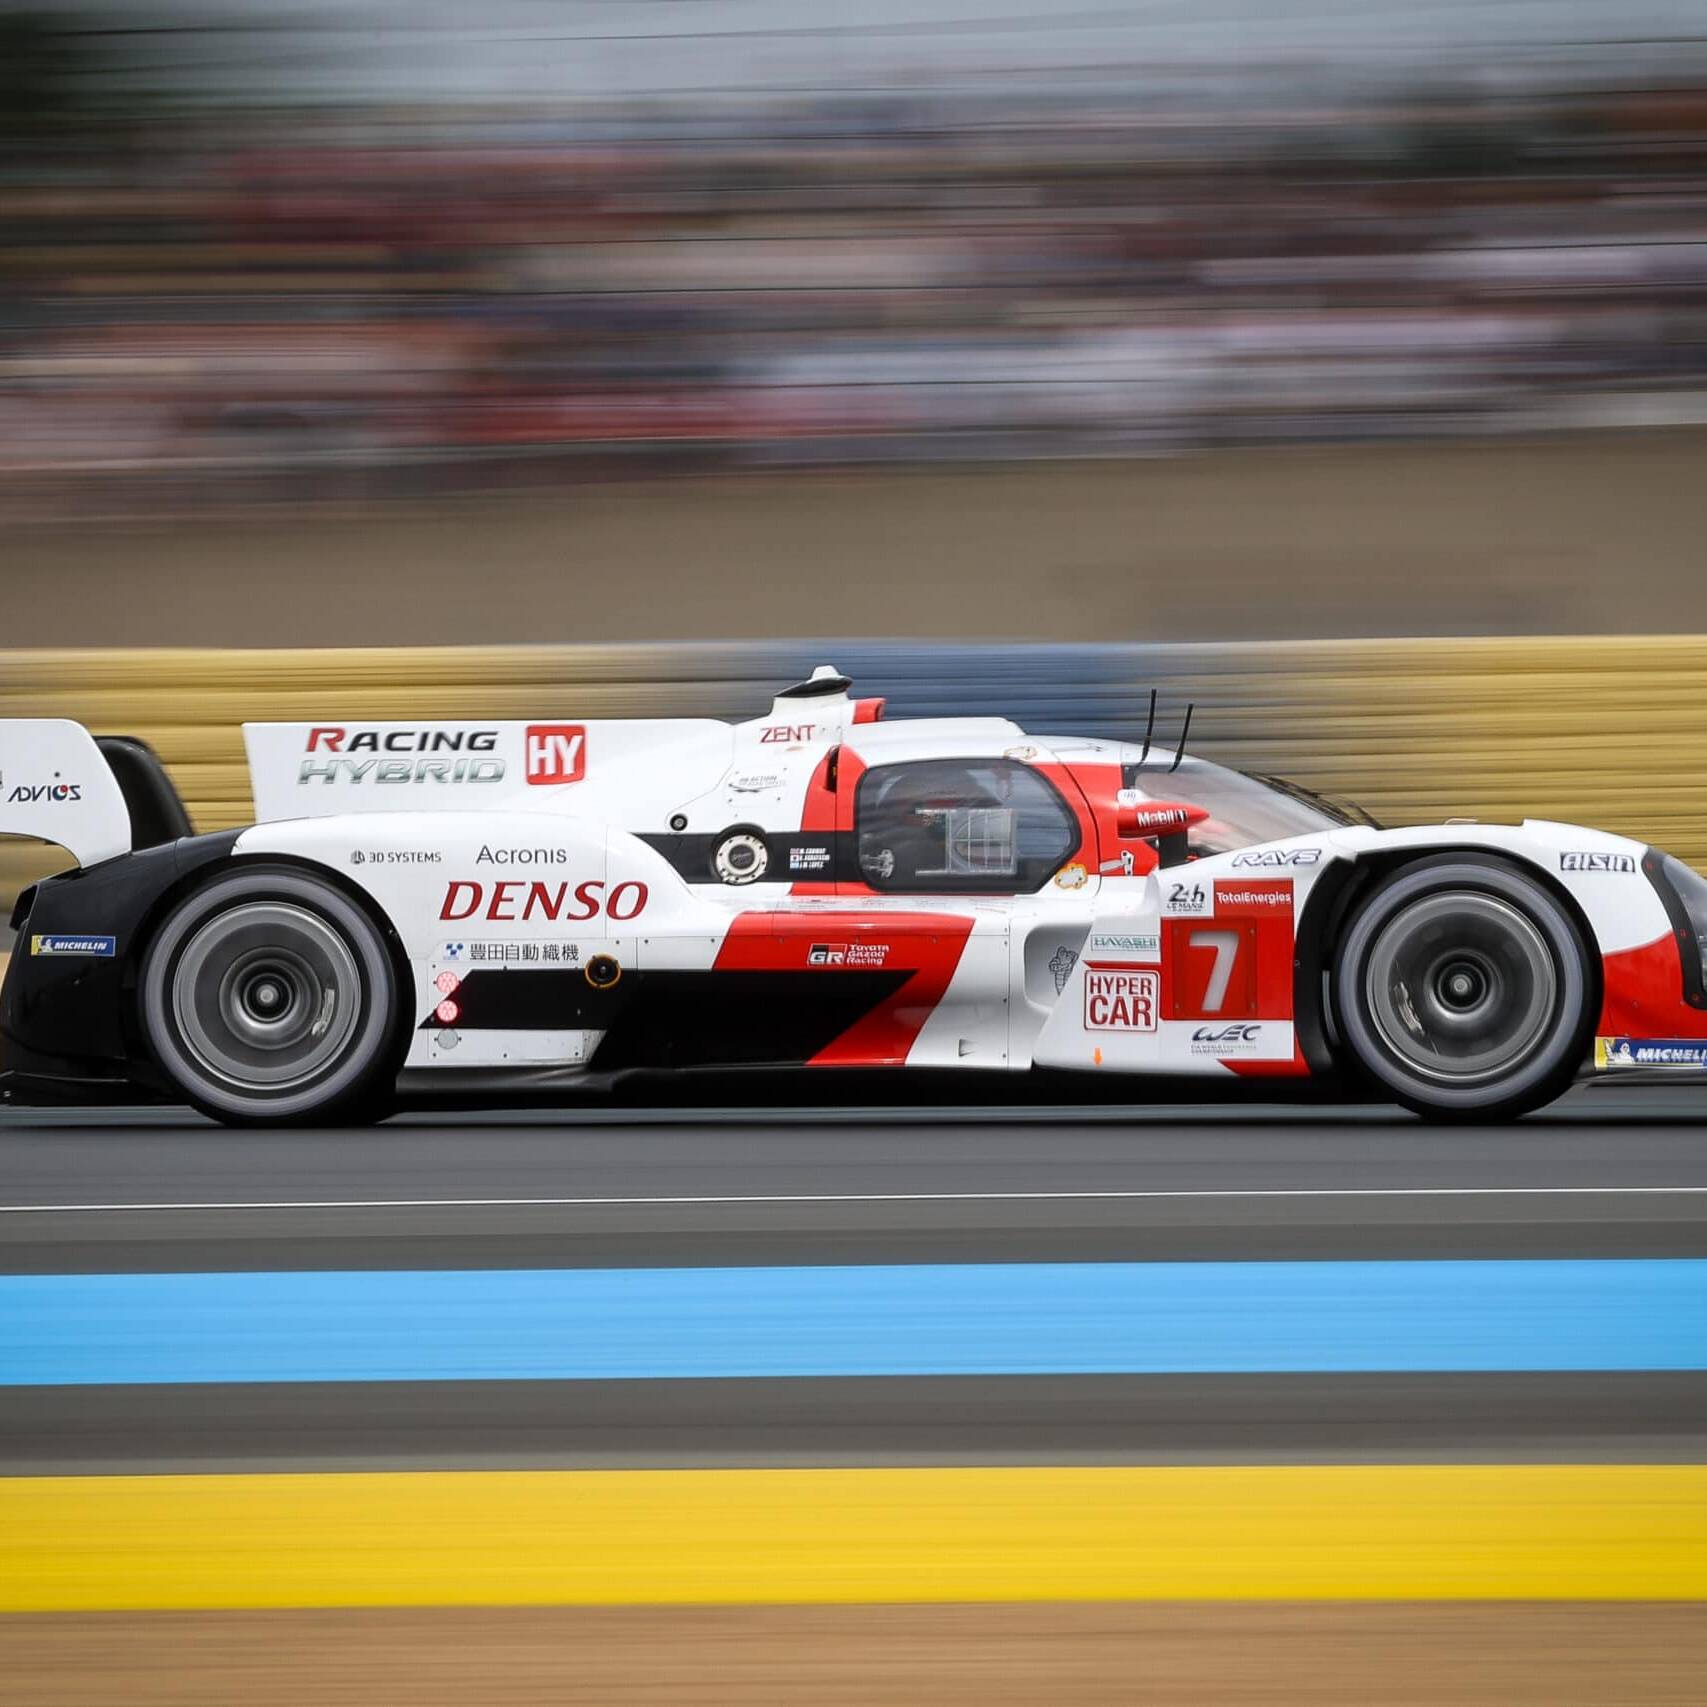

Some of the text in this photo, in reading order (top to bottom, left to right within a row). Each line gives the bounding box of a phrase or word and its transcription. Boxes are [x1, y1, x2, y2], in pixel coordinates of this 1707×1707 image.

[305, 728, 498, 752] RACING
[760, 725, 815, 743] ZENT
[528, 735, 583, 775] HY
[297, 758, 505, 784] HYBRID
[8, 784, 81, 802] ADVICS
[369, 852, 441, 863] 3D SYSTEMS
[476, 845, 567, 864] Acronis
[1232, 848, 1322, 867] RAYS
[1561, 852, 1635, 872] AISIN
[439, 881, 648, 920] DENSO
[1216, 891, 1291, 905] TotalEnergies
[54, 941, 107, 951] MICHELIN
[1094, 937, 1156, 946] HAYASHI
[810, 951, 844, 964] GR
[847, 957, 883, 965] Racing
[1189, 930, 1239, 1011] 7
[1089, 976, 1152, 995] HYPER
[1089, 995, 1152, 1026] CAR
[1192, 1024, 1262, 1041] WEC
[1637, 1047, 1707, 1060] MICHELI
